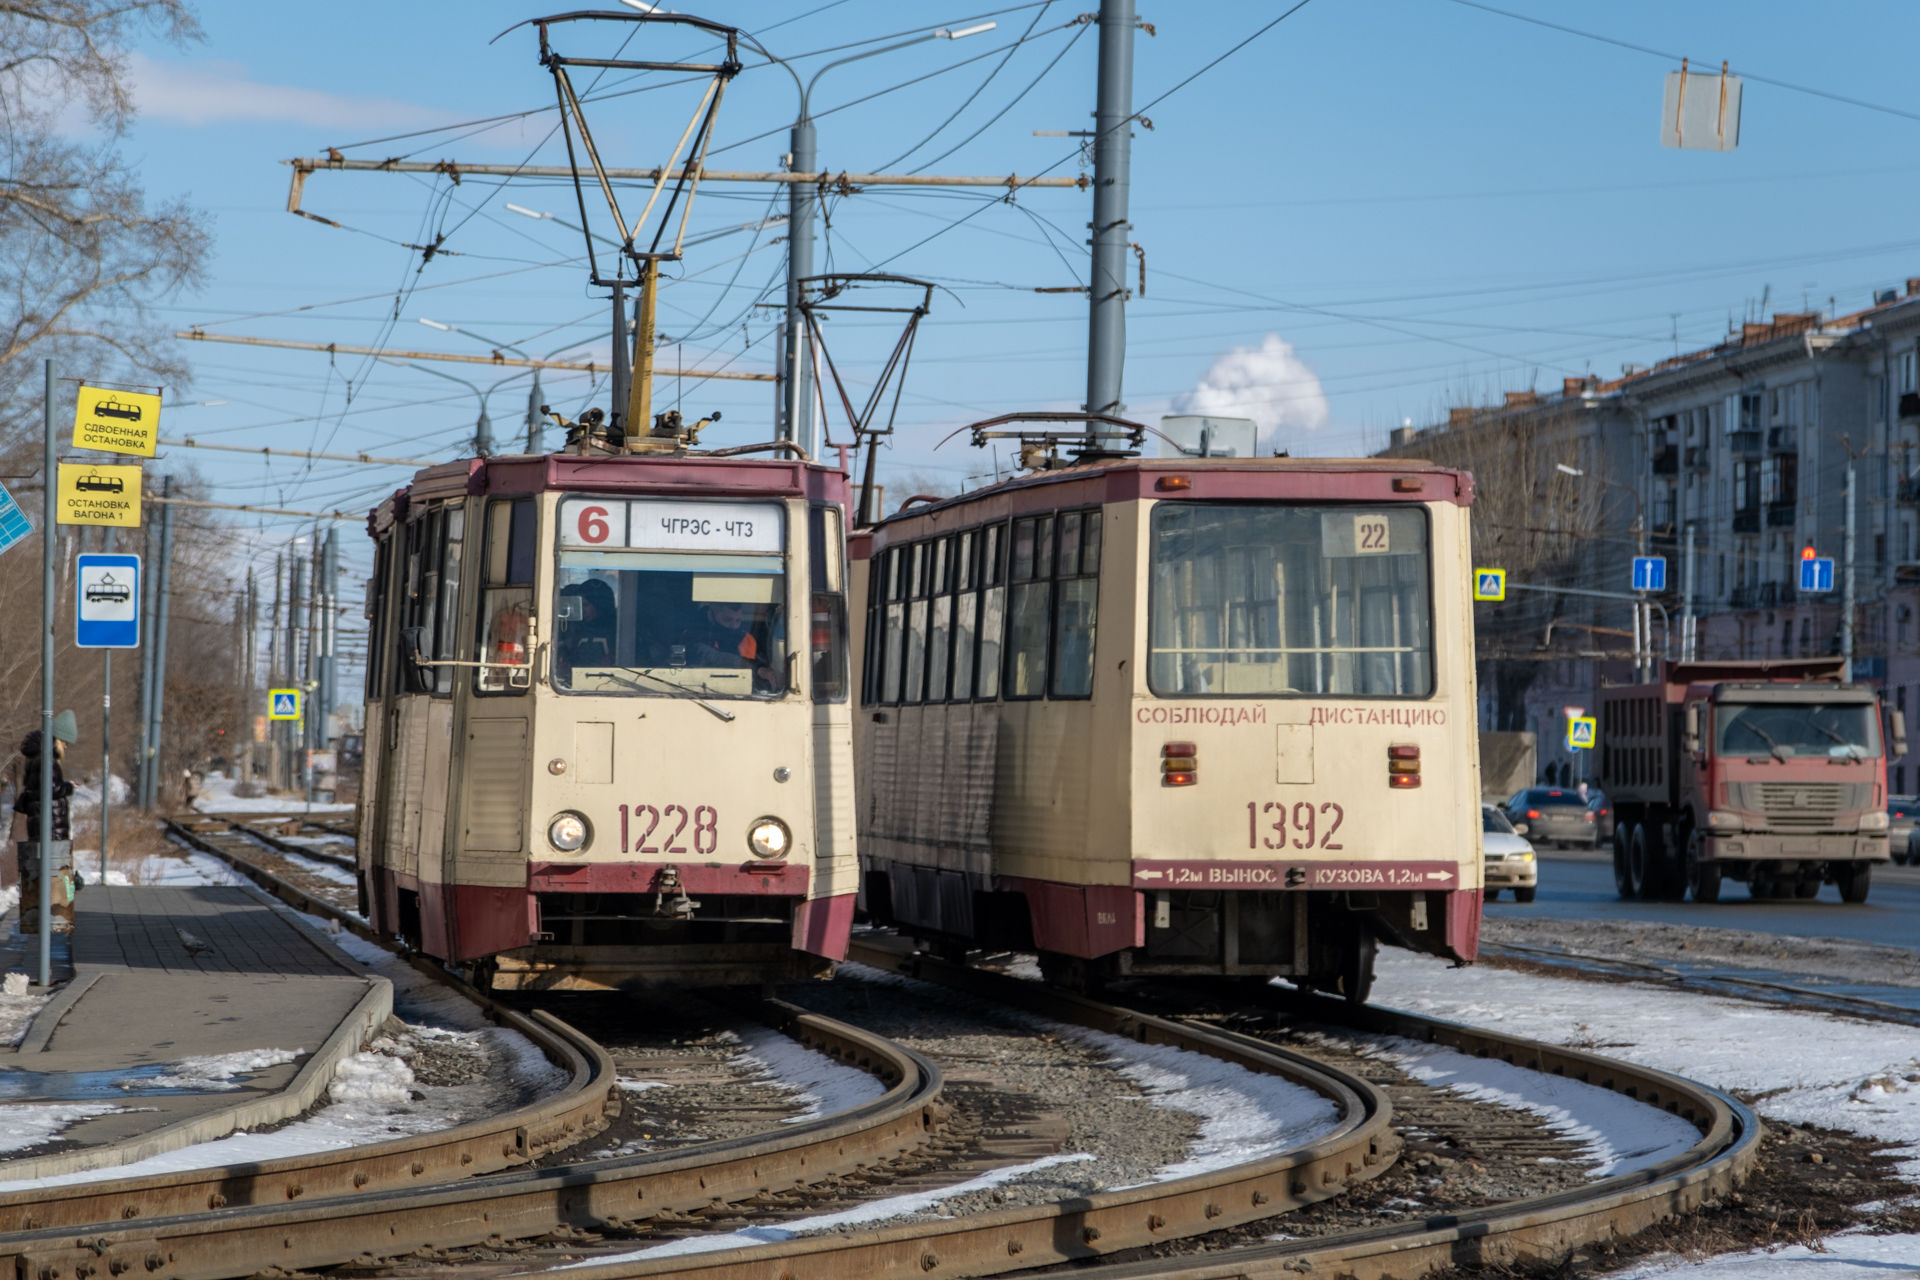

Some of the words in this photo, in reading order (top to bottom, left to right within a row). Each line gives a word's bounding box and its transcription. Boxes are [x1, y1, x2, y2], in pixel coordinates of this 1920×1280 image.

[84, 423, 148, 438] СДВОЕННАЯ
[84, 434, 145, 448] ОСТАНОВКА
[68, 499, 130, 510] ОСТАНОВКА
[74, 510, 115, 520] ВАГОНА
[118, 512, 123, 520] 1
[577, 506, 610, 544] 6
[661, 517, 711, 536] ЧГРЭС
[725, 521, 753, 538] ЧТЗ
[1361, 523, 1386, 549] 22
[1137, 704, 1267, 726] СОБЛЮДАЙ
[1309, 707, 1446, 727] ДИСТАНЦИЮ
[618, 804, 718, 854] 1228
[1247, 801, 1344, 850] 1392
[1209, 867, 1278, 884] ВЫНОС
[1315, 868, 1384, 884] КУЗОВА
